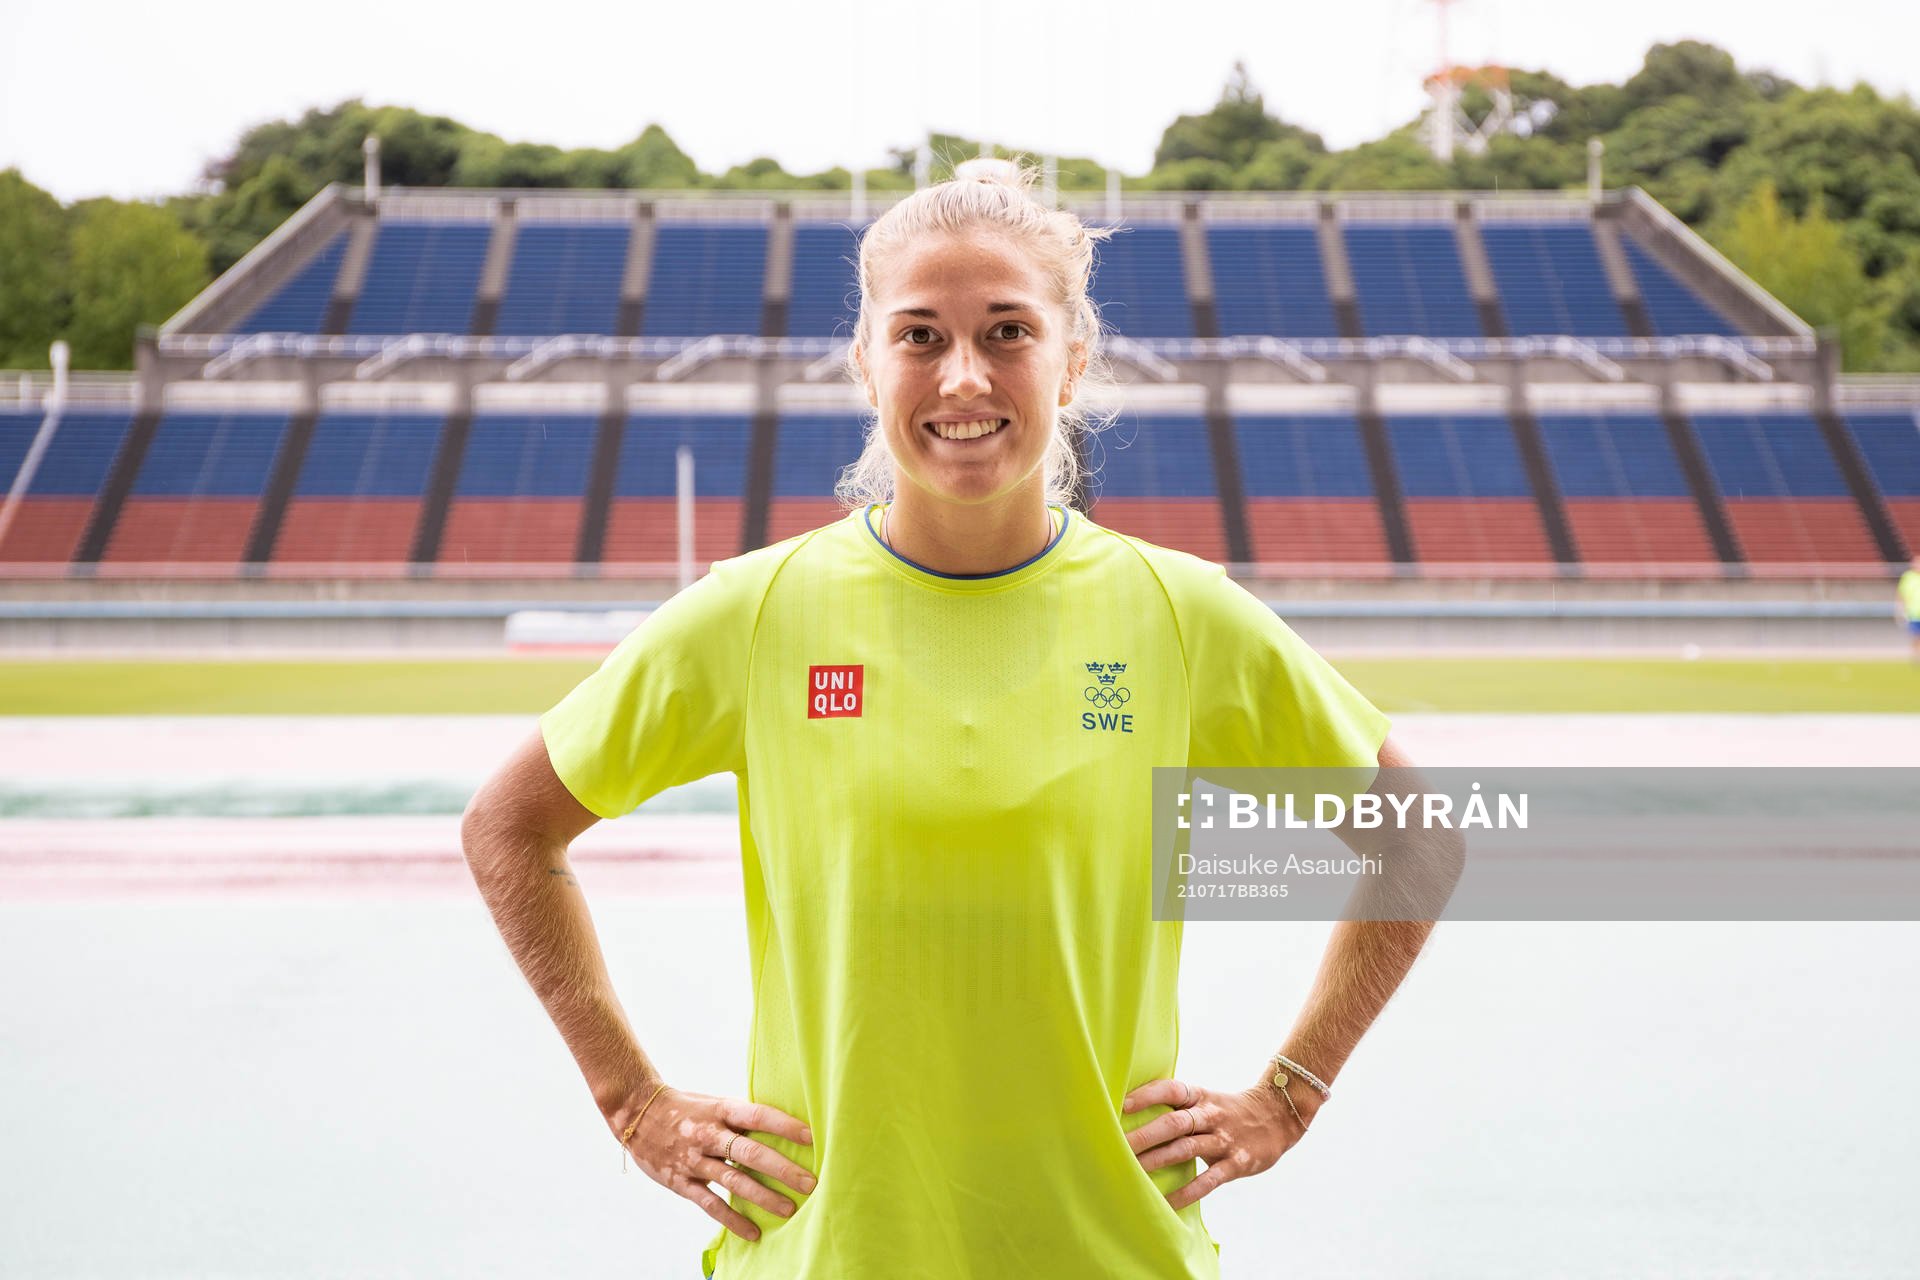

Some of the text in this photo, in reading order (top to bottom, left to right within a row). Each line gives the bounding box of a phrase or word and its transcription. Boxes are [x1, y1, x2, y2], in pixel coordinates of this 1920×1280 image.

[815, 672, 854, 690] UNI
[814, 693, 857, 715] QLO
[1082, 712, 1134, 733] SWE
